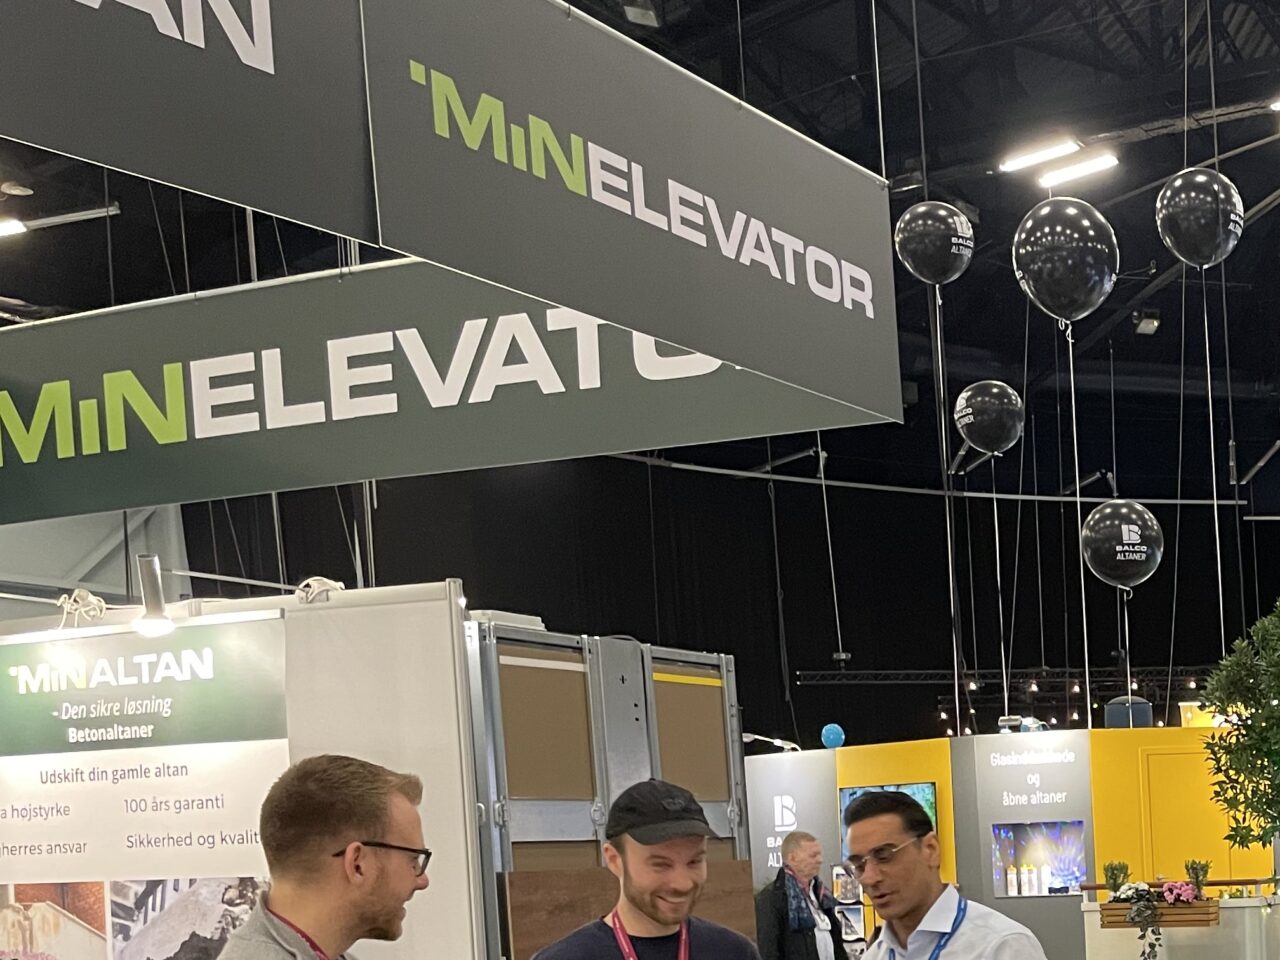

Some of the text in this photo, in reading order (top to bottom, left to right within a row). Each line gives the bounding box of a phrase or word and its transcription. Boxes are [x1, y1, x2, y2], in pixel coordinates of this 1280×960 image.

[1116, 552, 1146, 561] ALTANER
[61, 702, 86, 720] Den
[90, 698, 120, 719] sikre
[124, 696, 172, 717] løsning
[68, 724, 154, 743] Betonaltaner
[40, 763, 188, 784] Udskift din gamle altan
[1027, 773, 1040, 787] og
[124, 794, 224, 814] 100 års garanti
[1003, 791, 1067, 806] åbne altaner
[11, 802, 70, 821] højstyrke
[126, 829, 259, 849] Sikkerhed og kvalit
[0, 842, 87, 857] herres ansvar
